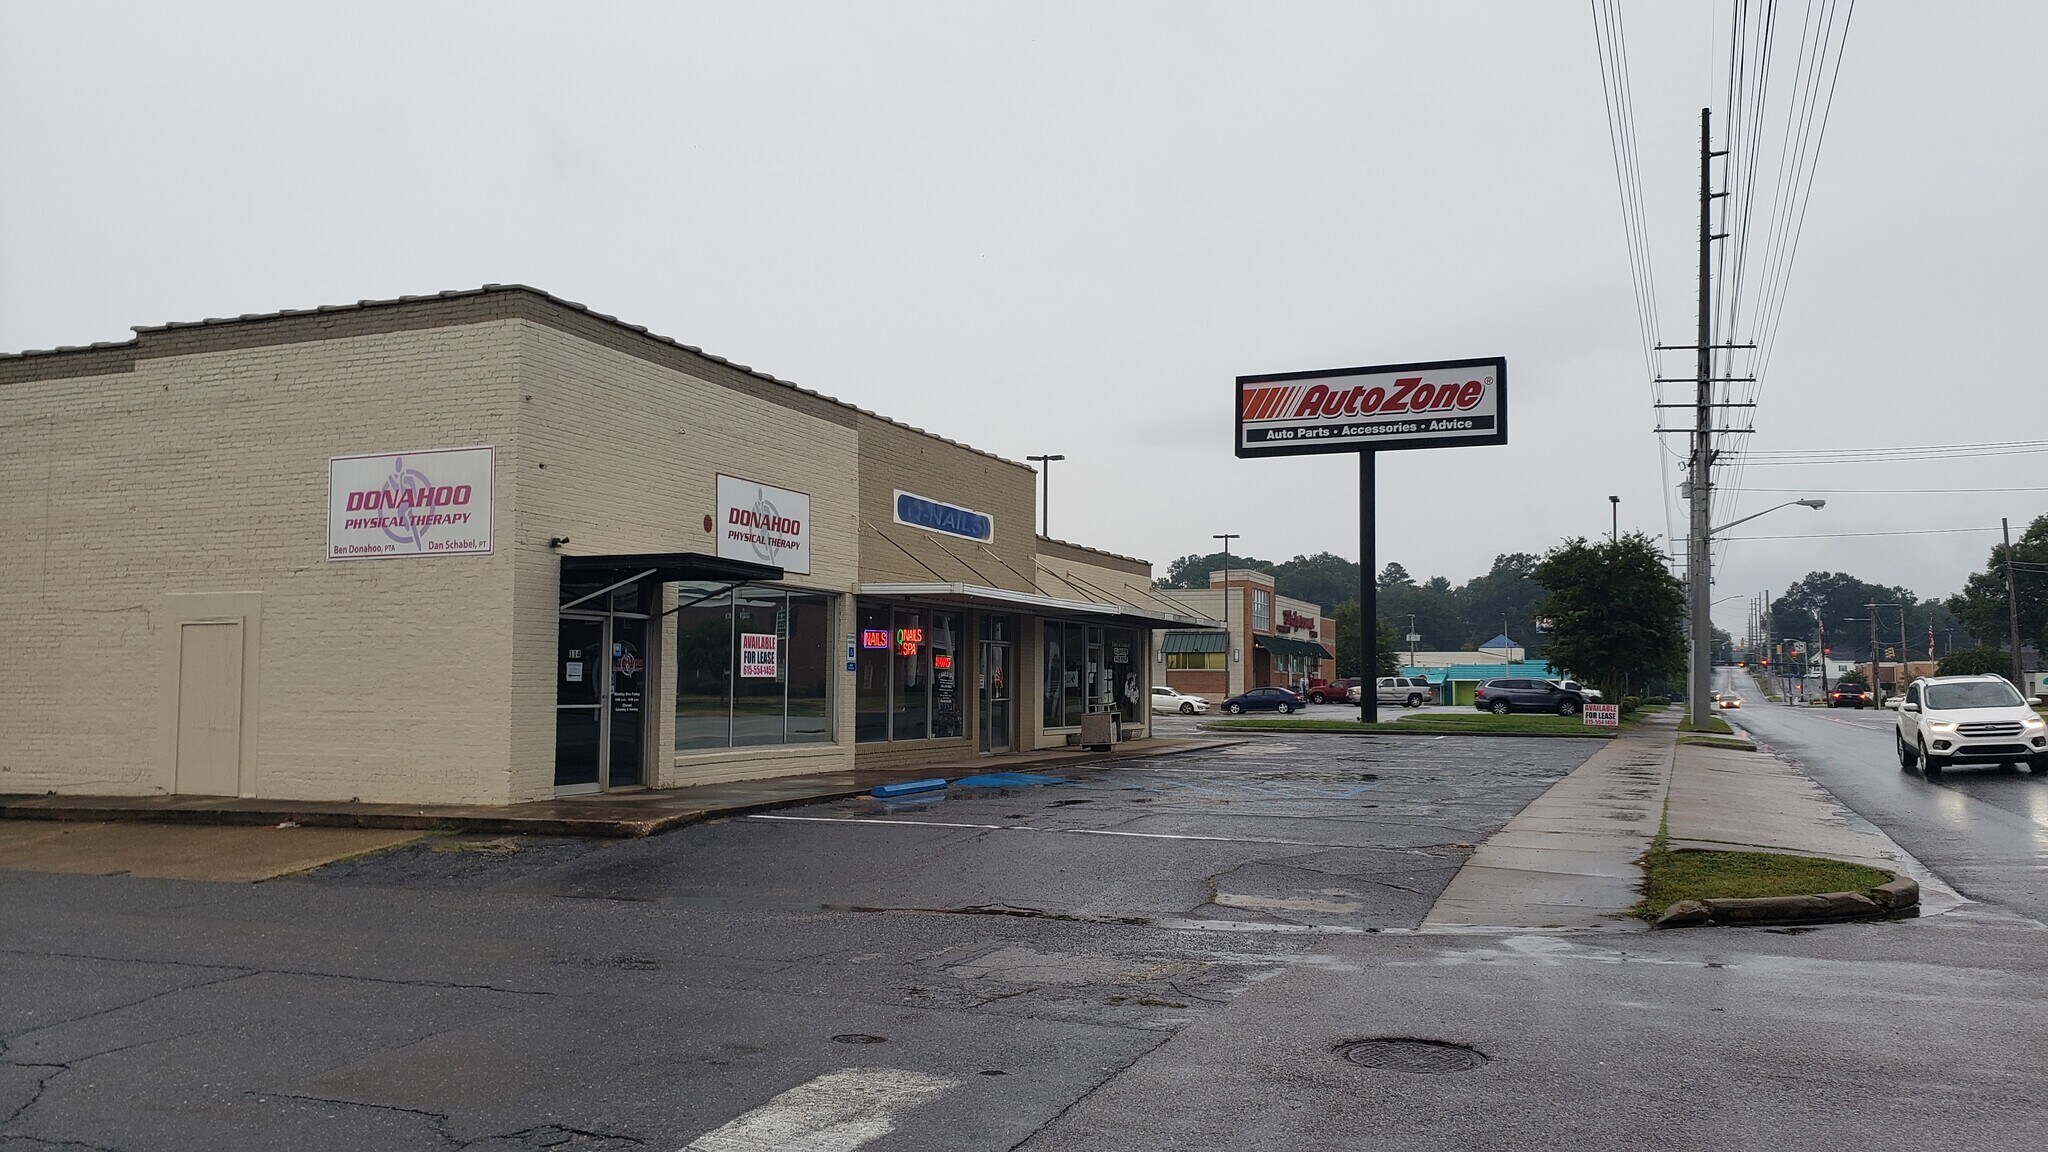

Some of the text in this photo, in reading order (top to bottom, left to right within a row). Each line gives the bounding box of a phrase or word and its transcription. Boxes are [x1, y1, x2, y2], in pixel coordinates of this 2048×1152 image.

[1293, 377, 1485, 418] AutoZone
[1266, 419, 1473, 440] Auto Parts Accessories Advice
[346, 484, 472, 512] DONAHOO
[344, 512, 472, 530] PHYSICAL THERAPY
[729, 507, 801, 536] DONAHOO
[428, 538, 487, 550] Dan Schabel, PT
[728, 530, 801, 550] PHYSICAL THERAPY
[333, 543, 396, 554] Ben Donahoo, PTA
[743, 635, 776, 650] AVAILABLE
[865, 632, 887, 647] NAILS
[903, 642, 917, 656] SPA
[743, 650, 775, 665] FOR LEASE
[1585, 704, 1617, 712] AVAILABLE
